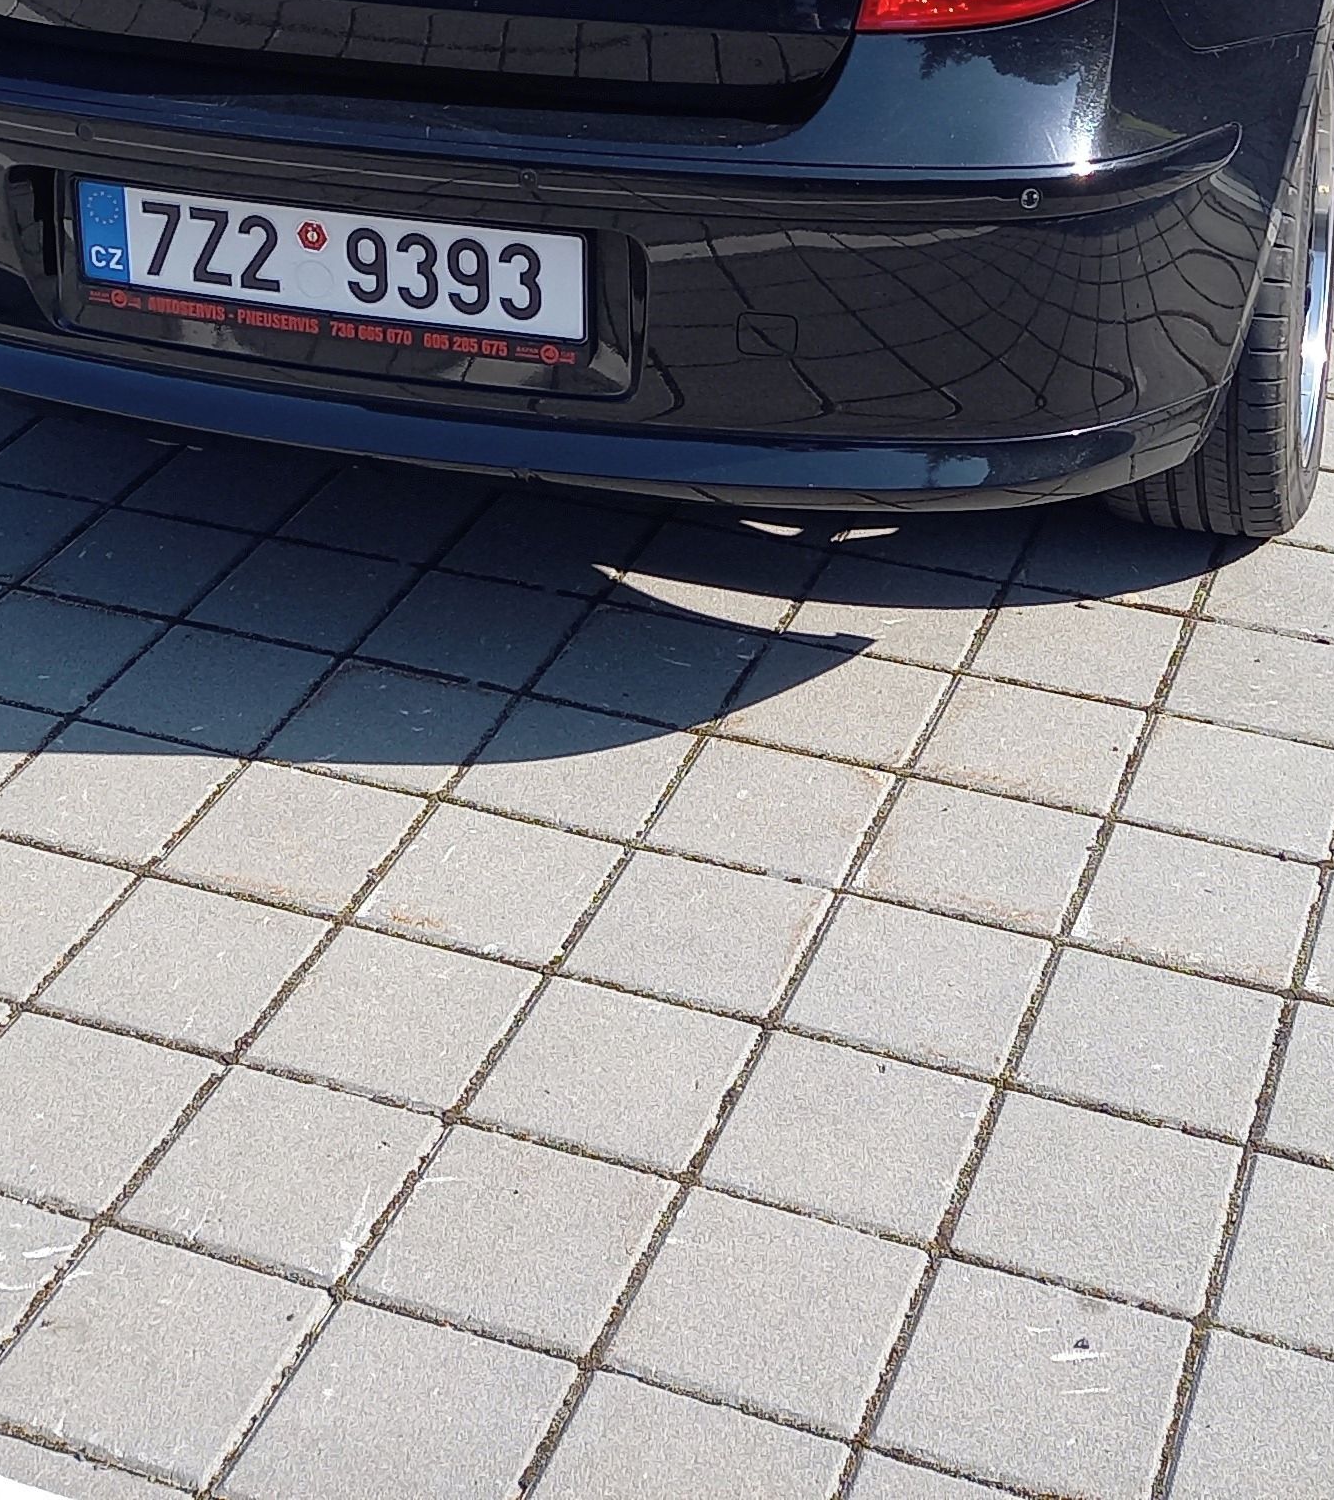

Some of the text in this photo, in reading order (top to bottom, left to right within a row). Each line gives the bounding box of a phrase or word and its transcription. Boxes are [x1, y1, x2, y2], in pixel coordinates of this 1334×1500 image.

[91, 200, 542, 321] CZ 7Z2 9393
[237, 308, 320, 335] PNEUSERVIS
